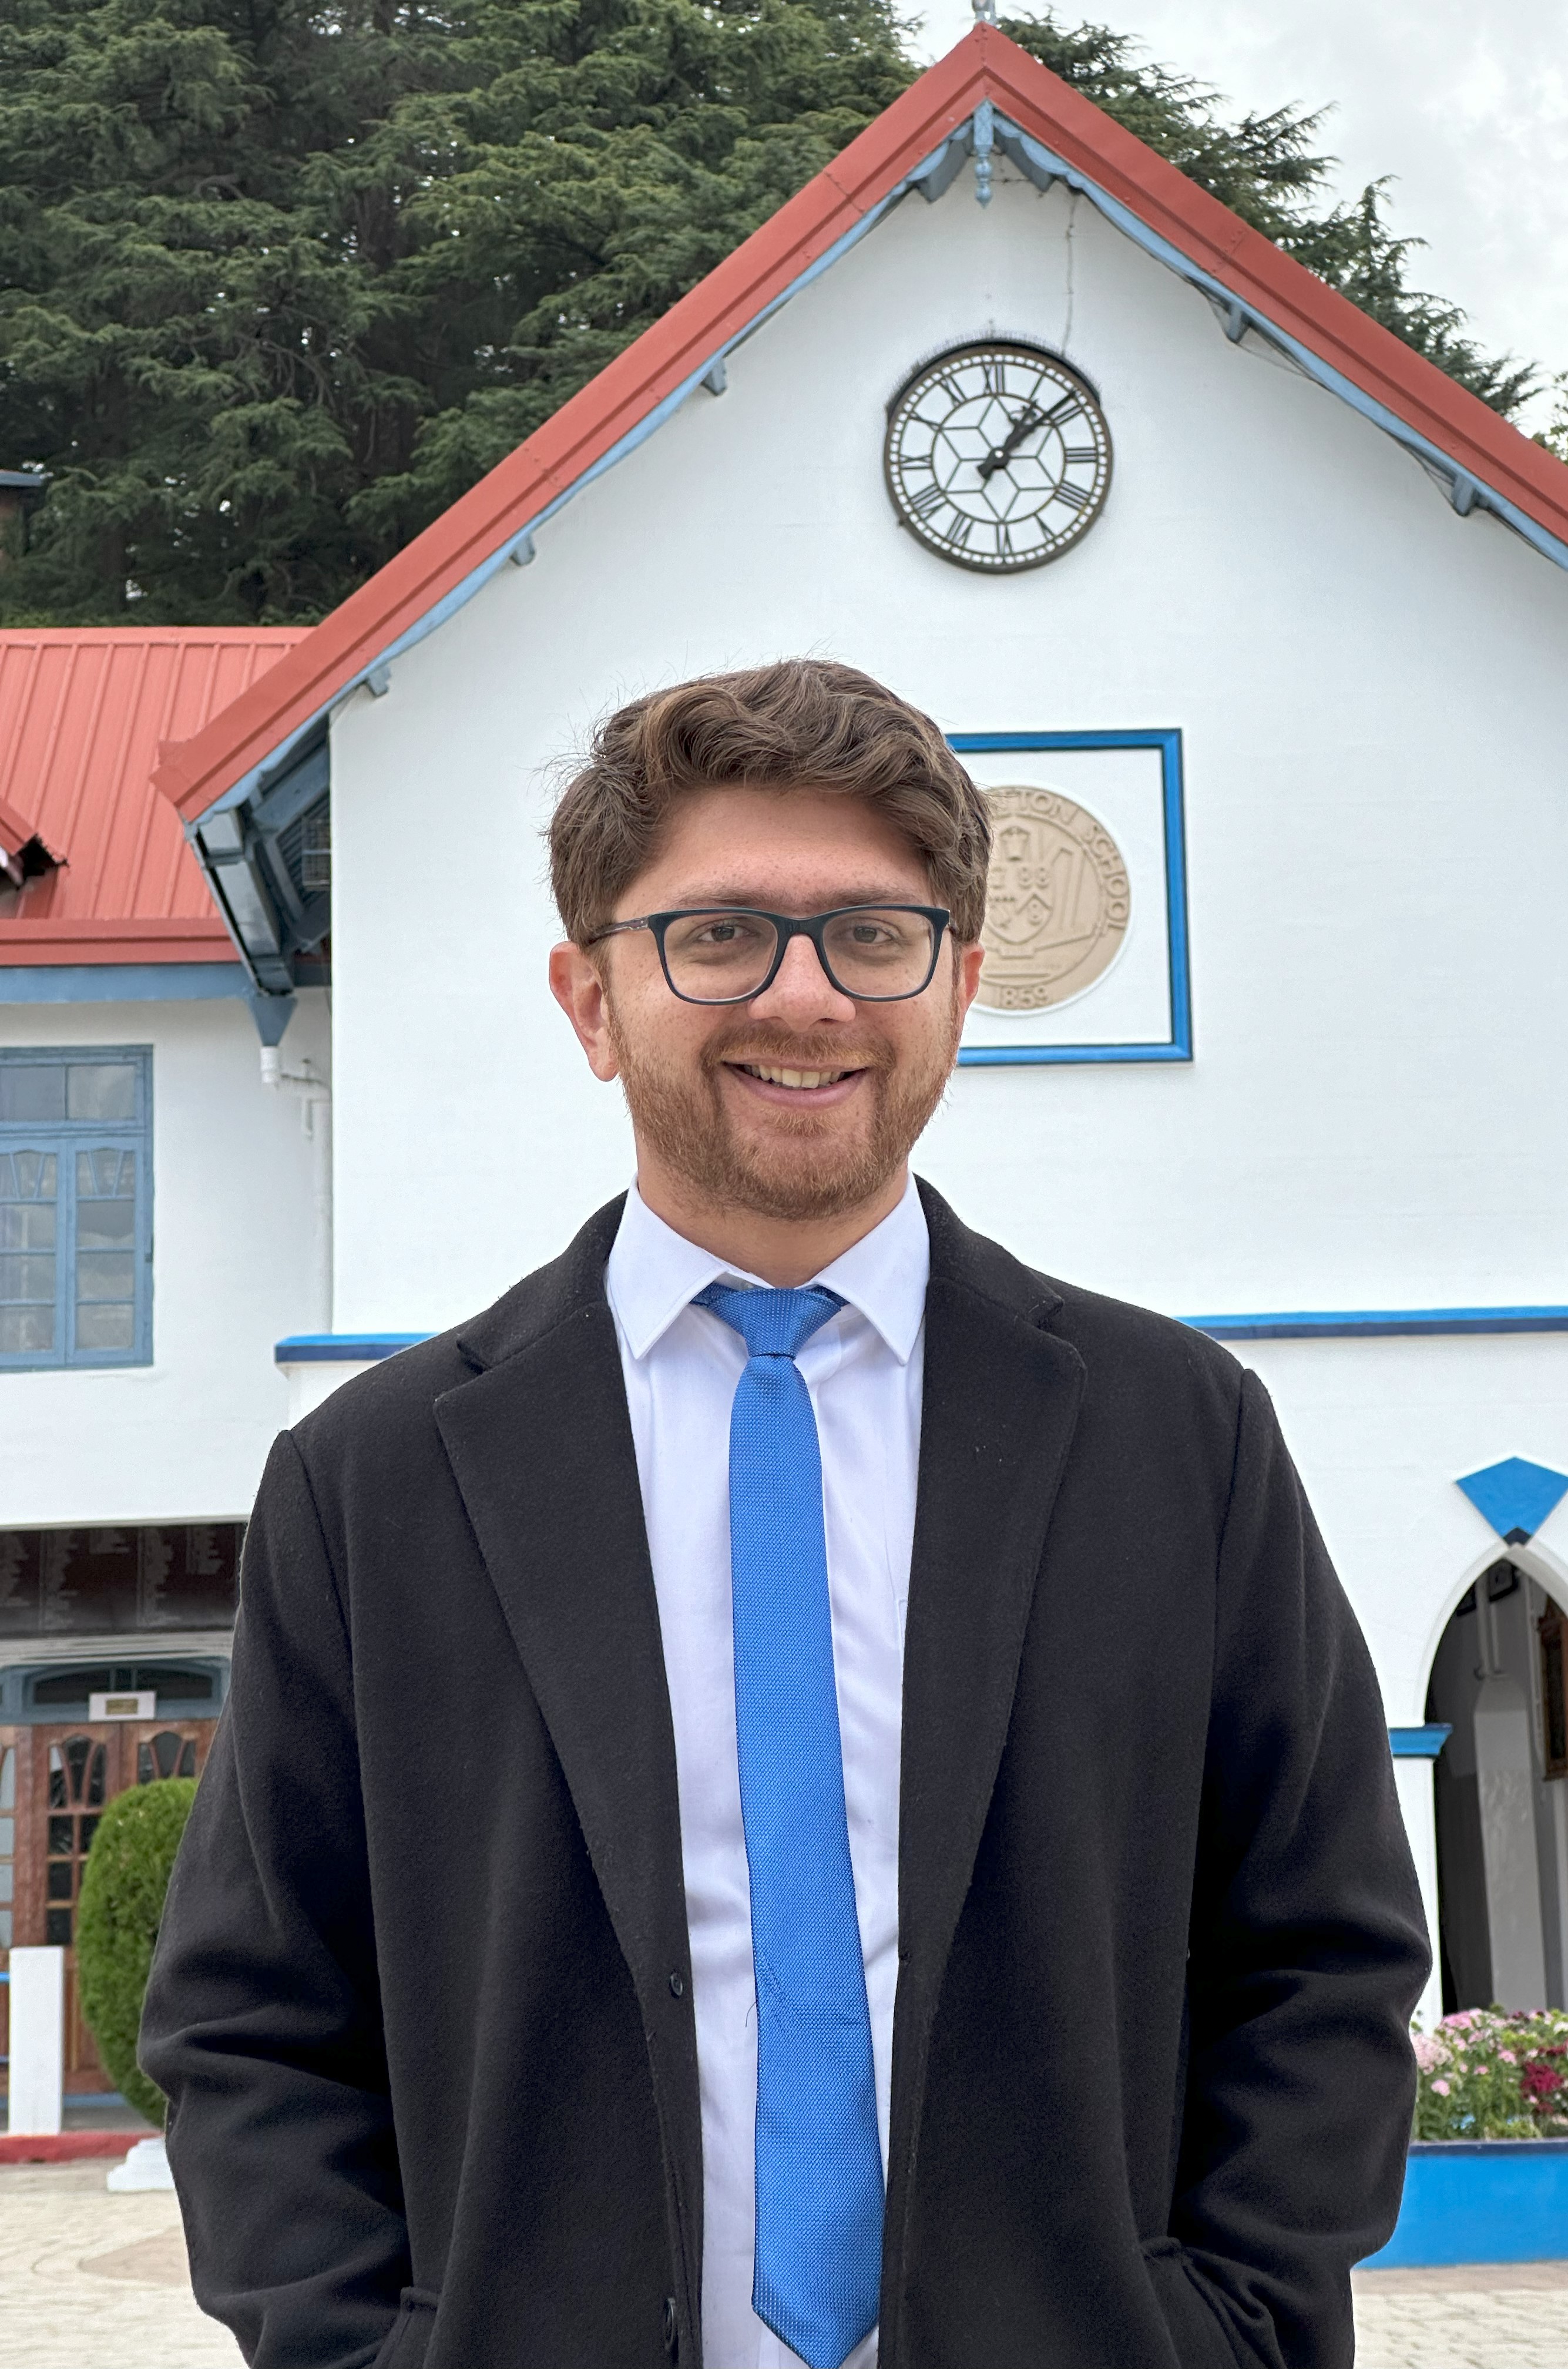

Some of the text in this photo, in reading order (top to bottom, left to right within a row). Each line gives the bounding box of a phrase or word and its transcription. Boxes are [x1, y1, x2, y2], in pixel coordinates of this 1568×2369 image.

[939, 375, 966, 407] XI
[982, 364, 1006, 394] XII
[1029, 375, 1044, 400] I
[908, 411, 941, 431] X
[1052, 405, 1083, 425] II
[899, 454, 932, 469] IX
[1065, 447, 1097, 462] III
[910, 483, 947, 518] VIII
[945, 512, 973, 546] VII
[995, 523, 1013, 554] VI
[1035, 513, 1056, 540] V
[1083, 824, 1129, 932] SCHOOL
[999, 985, 1048, 1009] 1859
